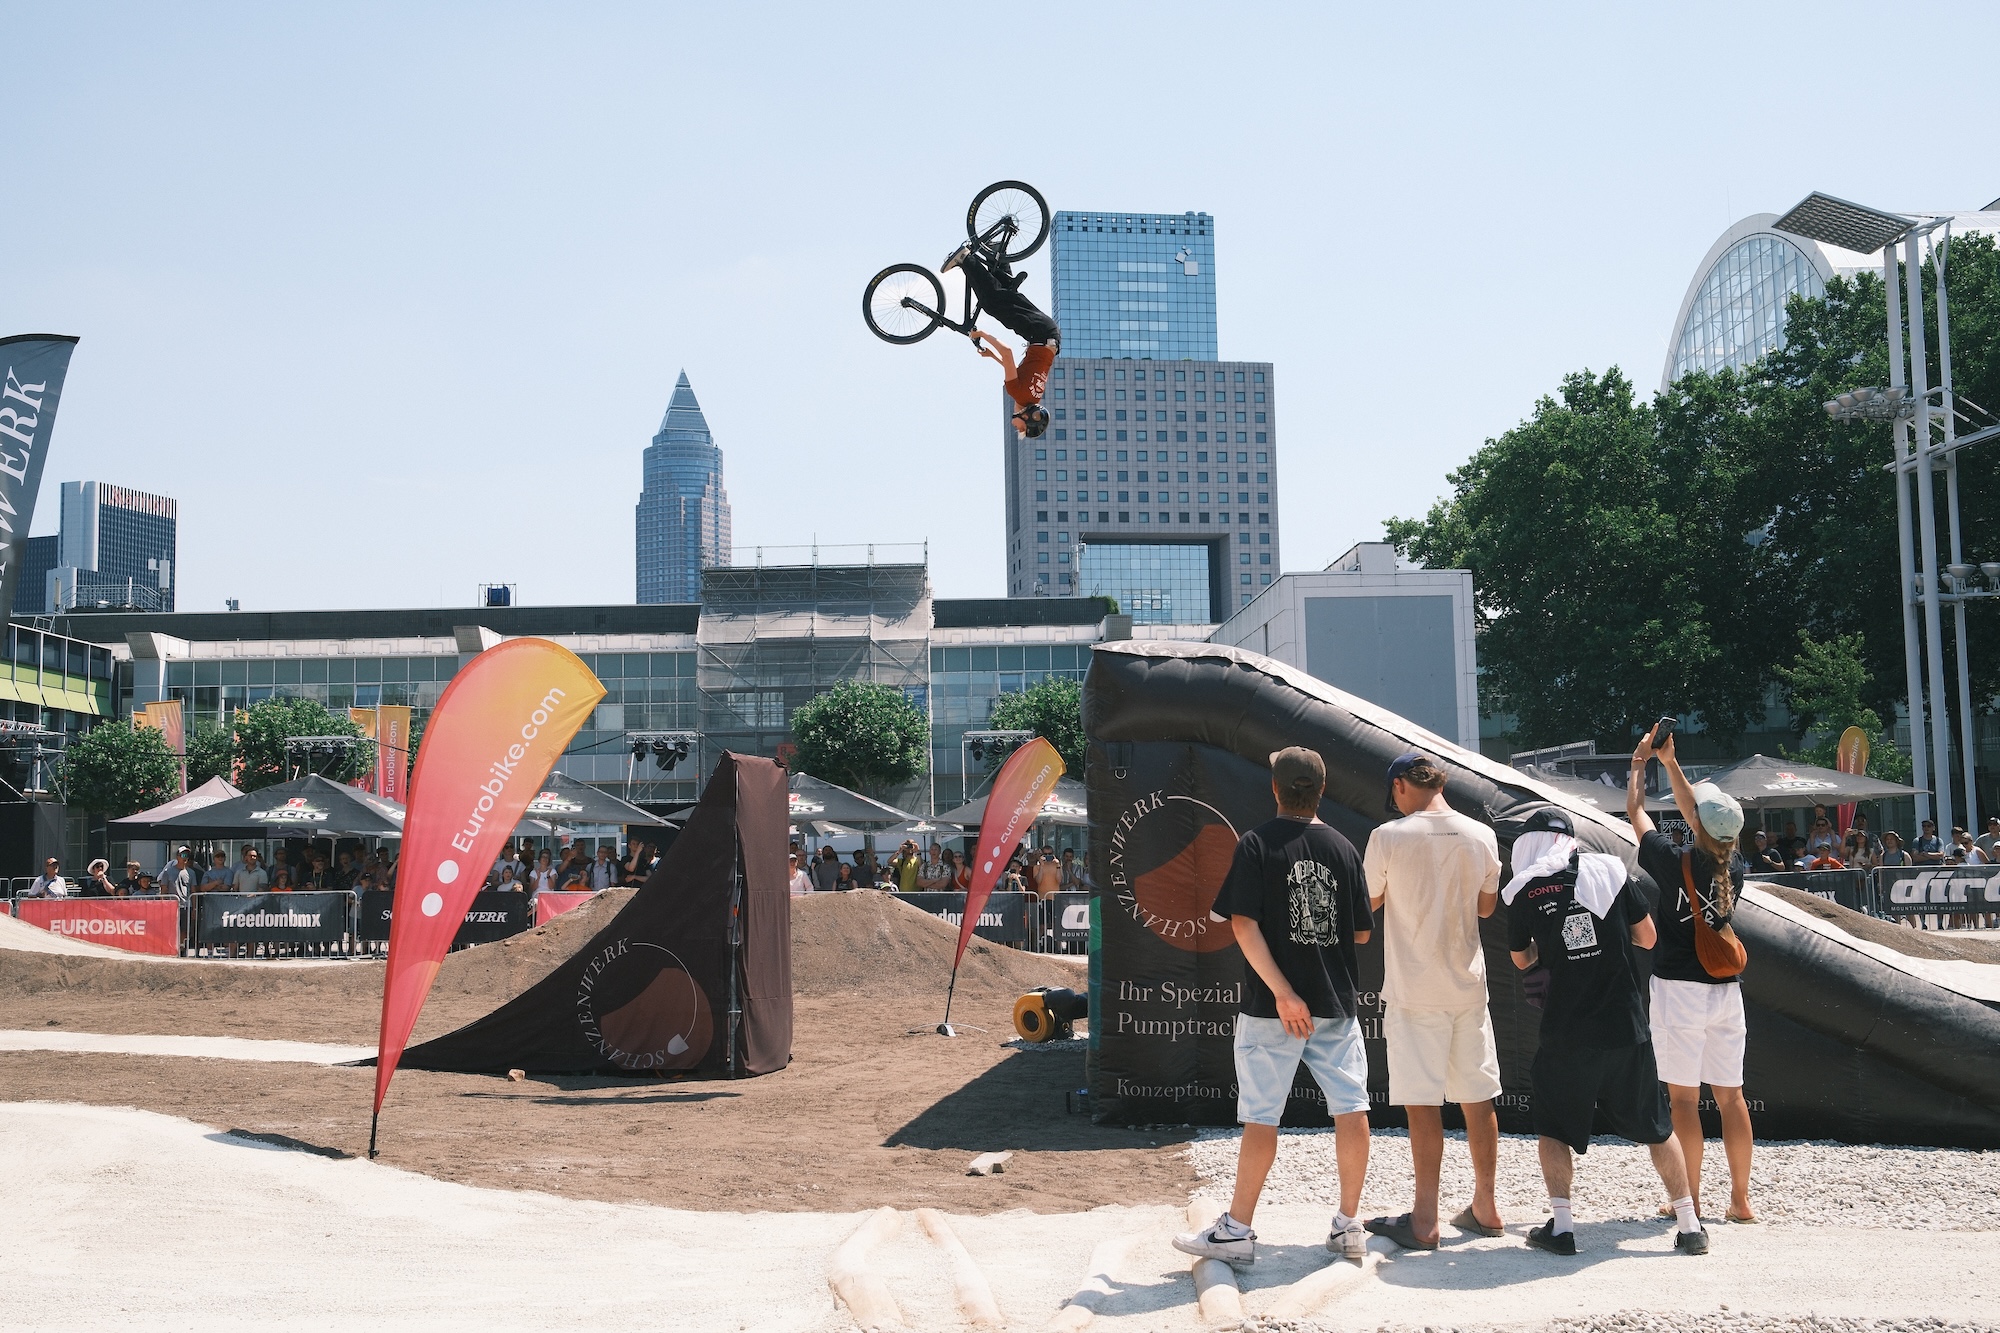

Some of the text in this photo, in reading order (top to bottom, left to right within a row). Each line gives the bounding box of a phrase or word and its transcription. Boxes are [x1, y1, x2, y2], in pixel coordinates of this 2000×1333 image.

[386, 720, 397, 793] Eurobike.com
[451, 686, 566, 854] Eurobike.com
[1849, 736, 1859, 774] urobike
[1110, 789, 1207, 938] SCHANZENWERK
[50, 919, 146, 936] EUROBIKE
[221, 908, 321, 928] freedombmx
[577, 937, 665, 1069] SCHANZENWERK
[1119, 980, 1153, 1002] Ihr
[1160, 981, 1242, 1010] Spezial
[1116, 1078, 1221, 1102] Konzeption
